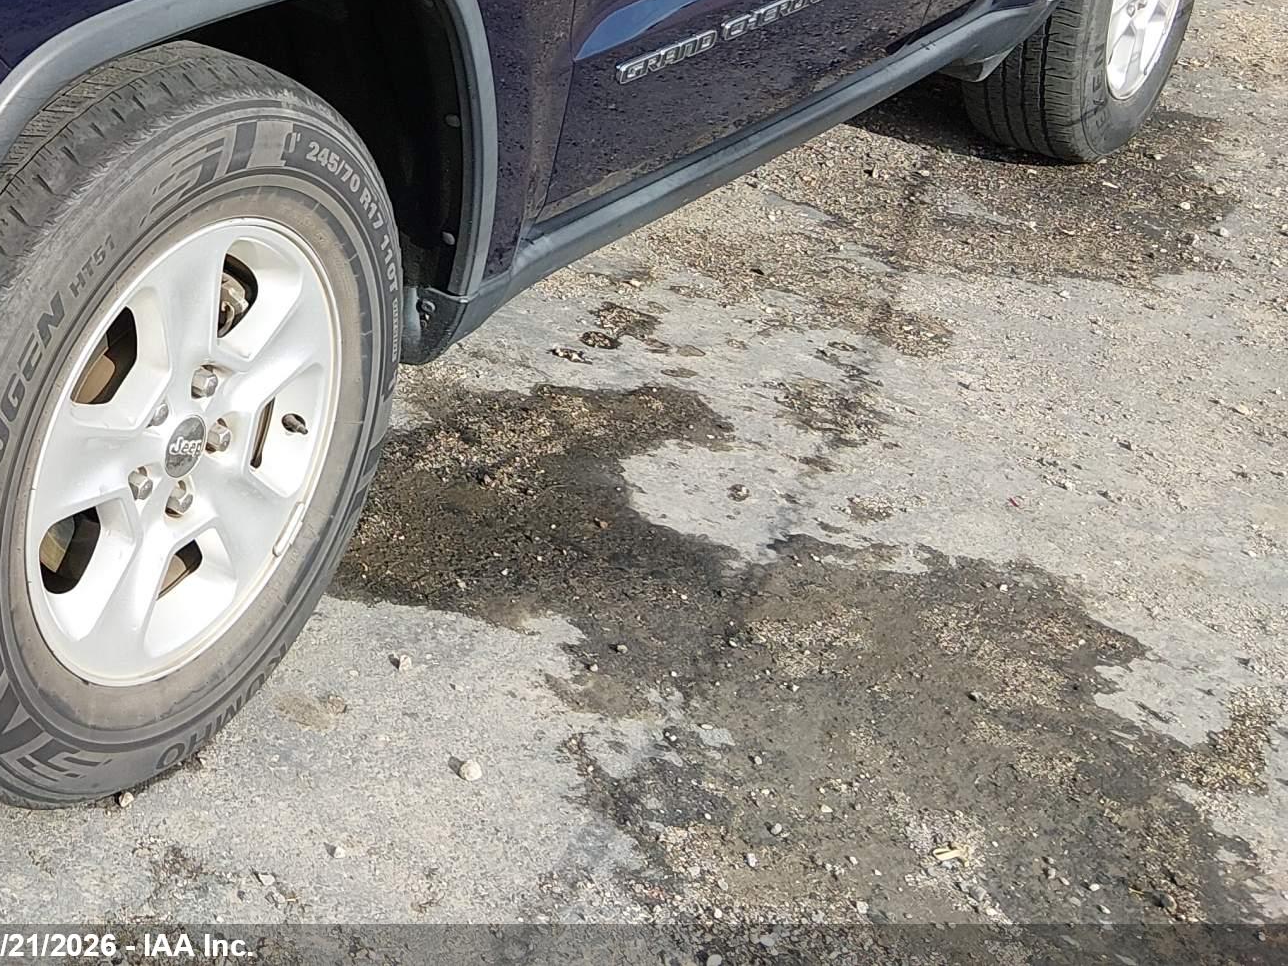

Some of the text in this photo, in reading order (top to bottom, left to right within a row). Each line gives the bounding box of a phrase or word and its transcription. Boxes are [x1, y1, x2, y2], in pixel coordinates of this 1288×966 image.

[615, 30, 718, 84] GRAND
[305, 141, 361, 193] 245/70
[359, 187, 384, 230] R17
[69, 233, 116, 299] HT51
[169, 436, 203, 458] Jeep
